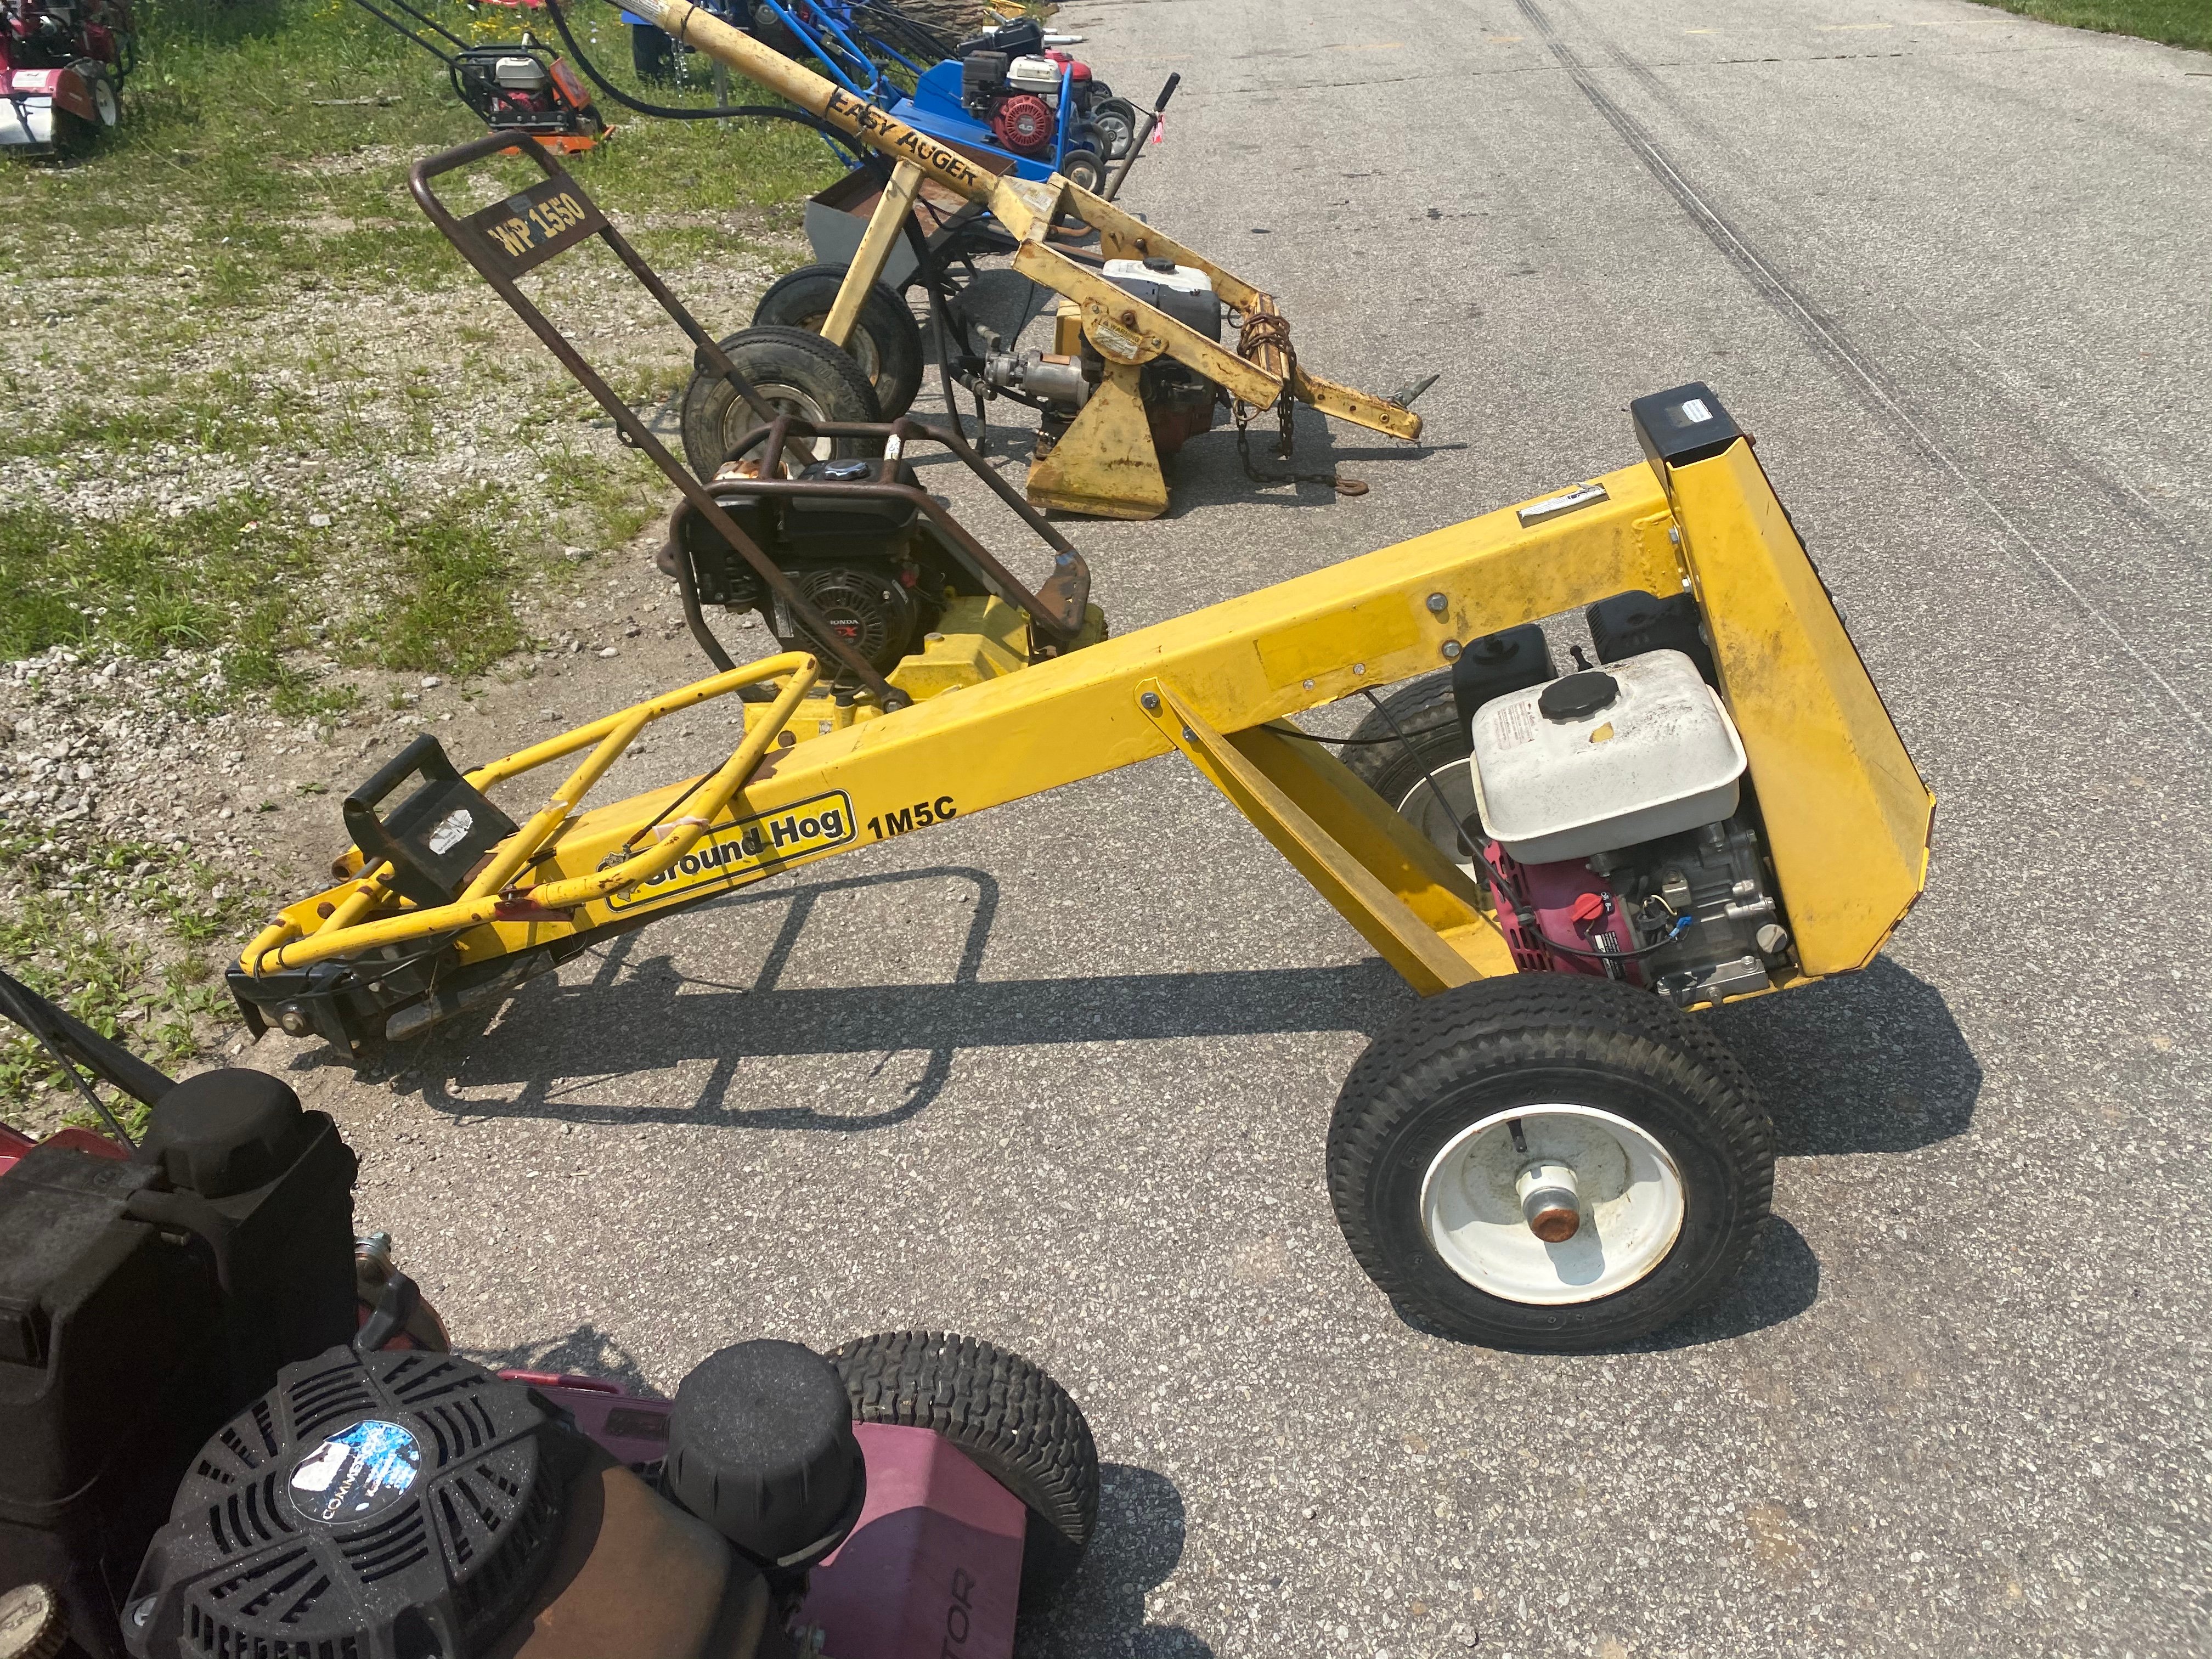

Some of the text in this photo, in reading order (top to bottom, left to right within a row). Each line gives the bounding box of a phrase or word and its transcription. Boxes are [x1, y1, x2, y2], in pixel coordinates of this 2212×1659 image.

[829, 92, 978, 187] EASY AUGER
[487, 193, 585, 257] WP 1550
[645, 809, 844, 885] round Hog
[867, 795, 957, 839] 1M5C
